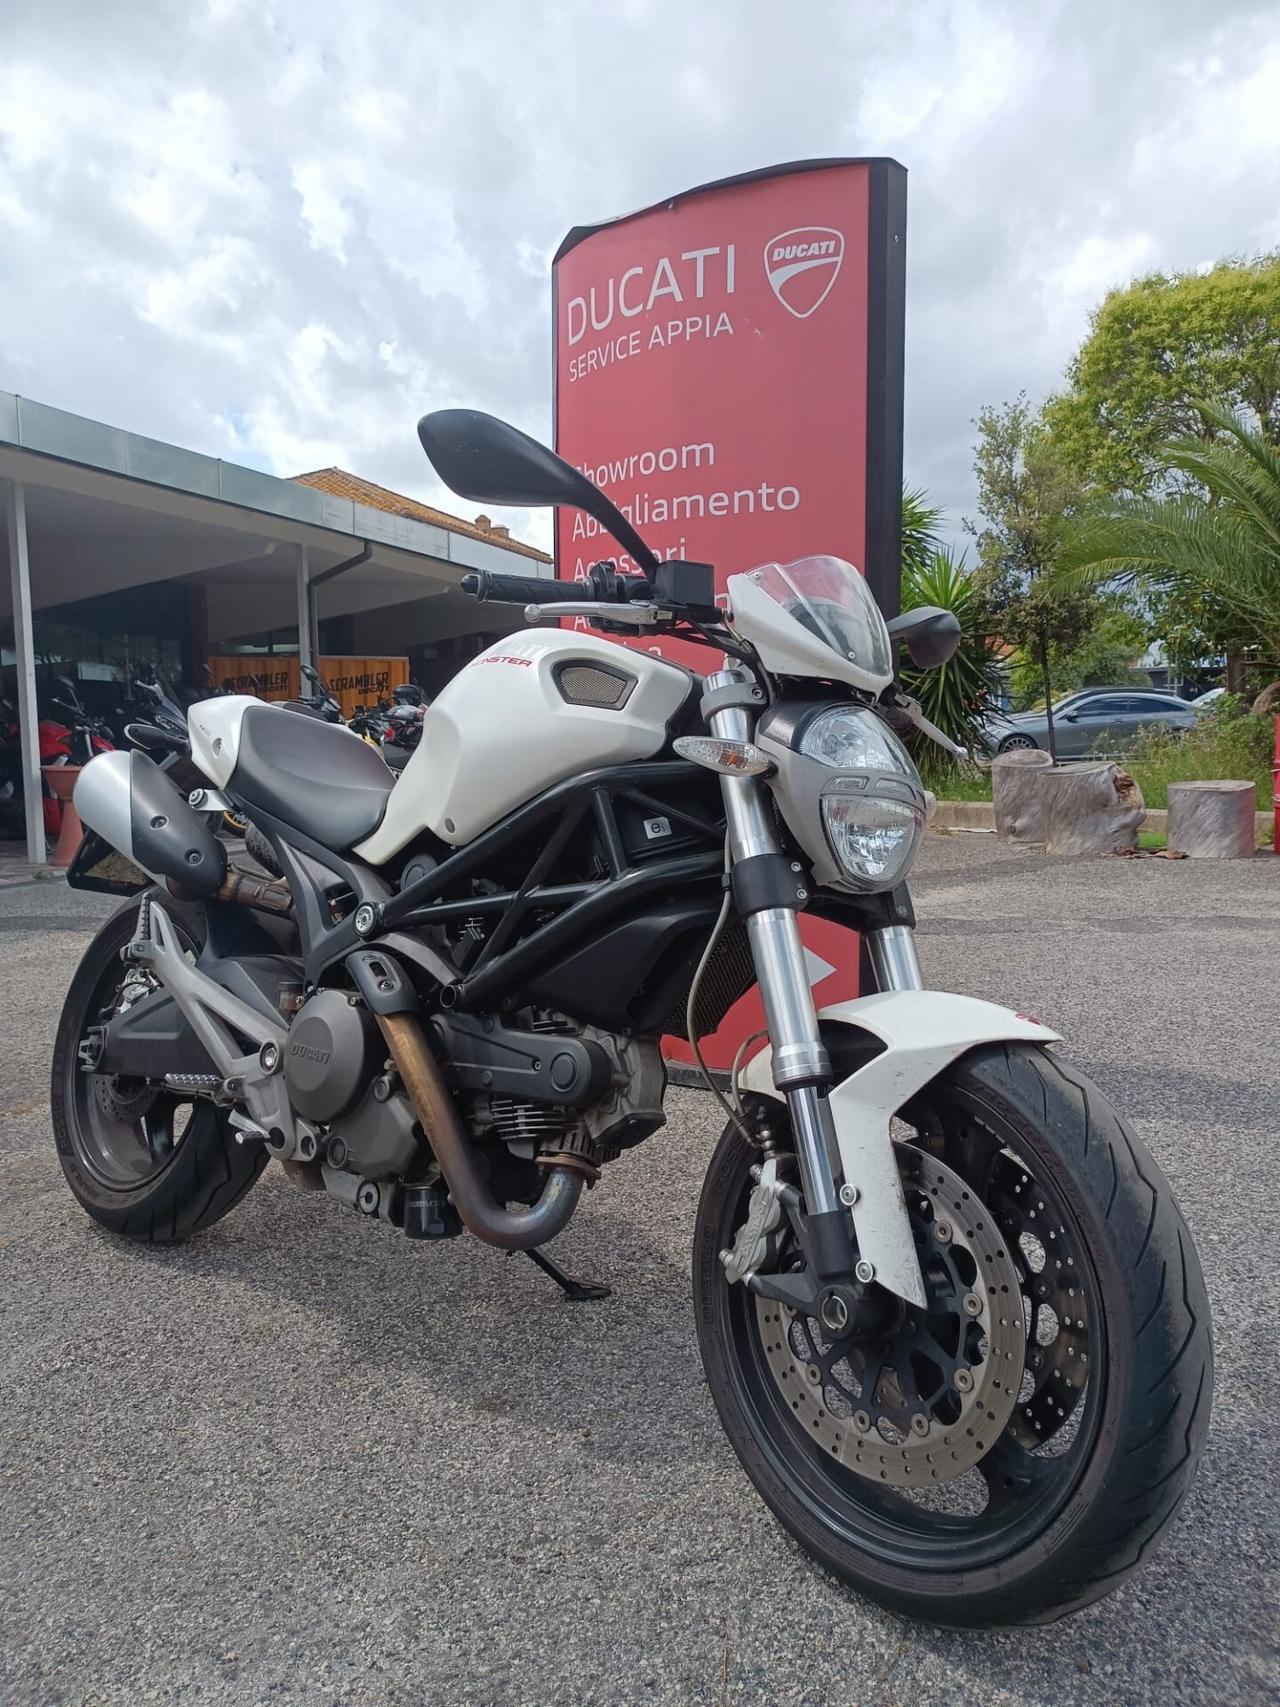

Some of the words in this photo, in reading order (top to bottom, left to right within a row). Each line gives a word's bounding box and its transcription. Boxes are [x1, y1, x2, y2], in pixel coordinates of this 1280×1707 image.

[772, 240, 836, 262] DUCATI
[567, 244, 736, 347] DUCATI
[568, 330, 642, 383] SERVICE
[648, 312, 734, 350] APPIA
[576, 442, 715, 488] howroom
[290, 1041, 331, 1065] DUCATI
